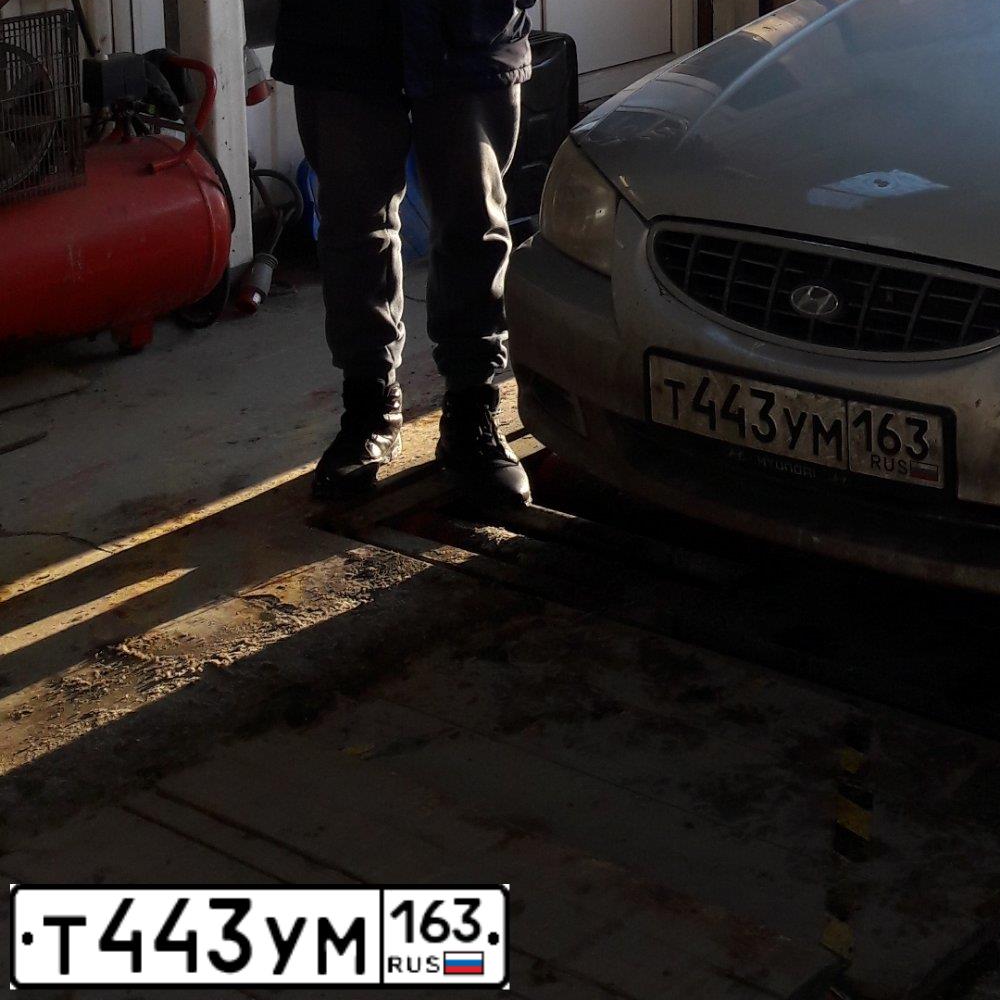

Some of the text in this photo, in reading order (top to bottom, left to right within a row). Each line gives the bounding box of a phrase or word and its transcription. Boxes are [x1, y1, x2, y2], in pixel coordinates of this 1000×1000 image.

[664, 376, 929, 461] Т443УМ 163
[870, 454, 908, 475] RUS
